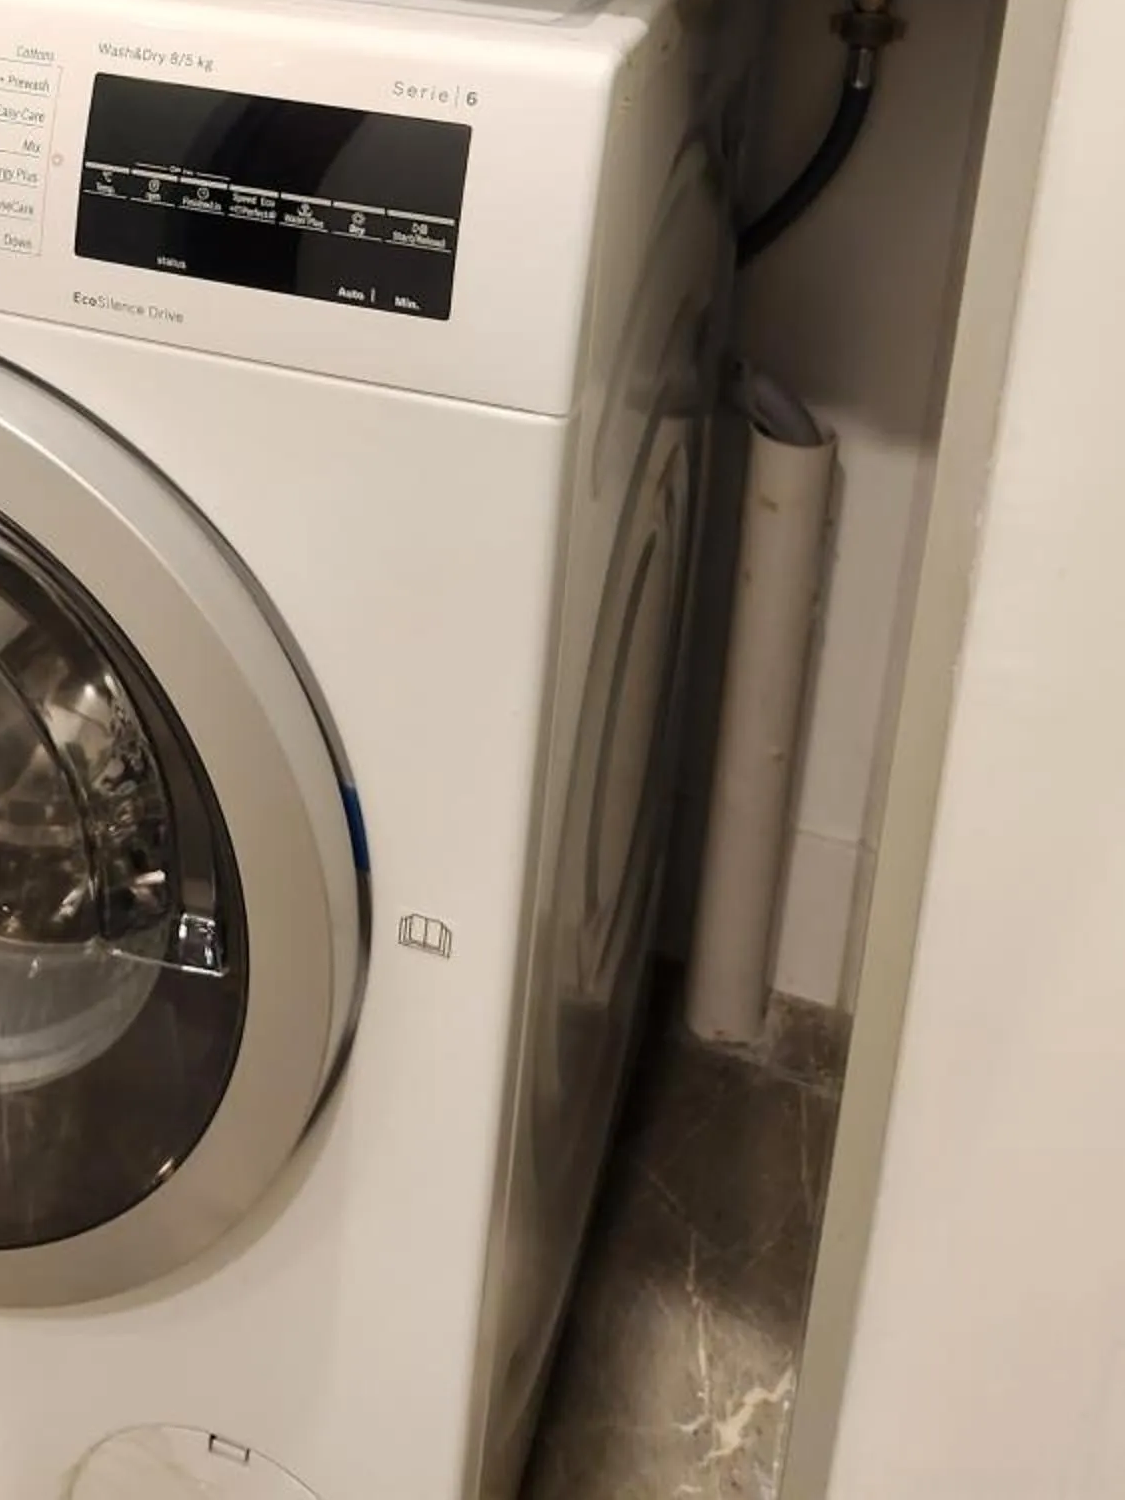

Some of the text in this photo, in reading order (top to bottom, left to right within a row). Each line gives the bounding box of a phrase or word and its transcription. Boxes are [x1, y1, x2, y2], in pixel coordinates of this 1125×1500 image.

[97, 41, 214, 73] Wash&Dry 8/5 kg
[393, 80, 478, 106] Serie 6
[337, 286, 365, 301] Auto
[394, 296, 421, 310] Min.
[73, 291, 185, 324] EcoSilence Drive
